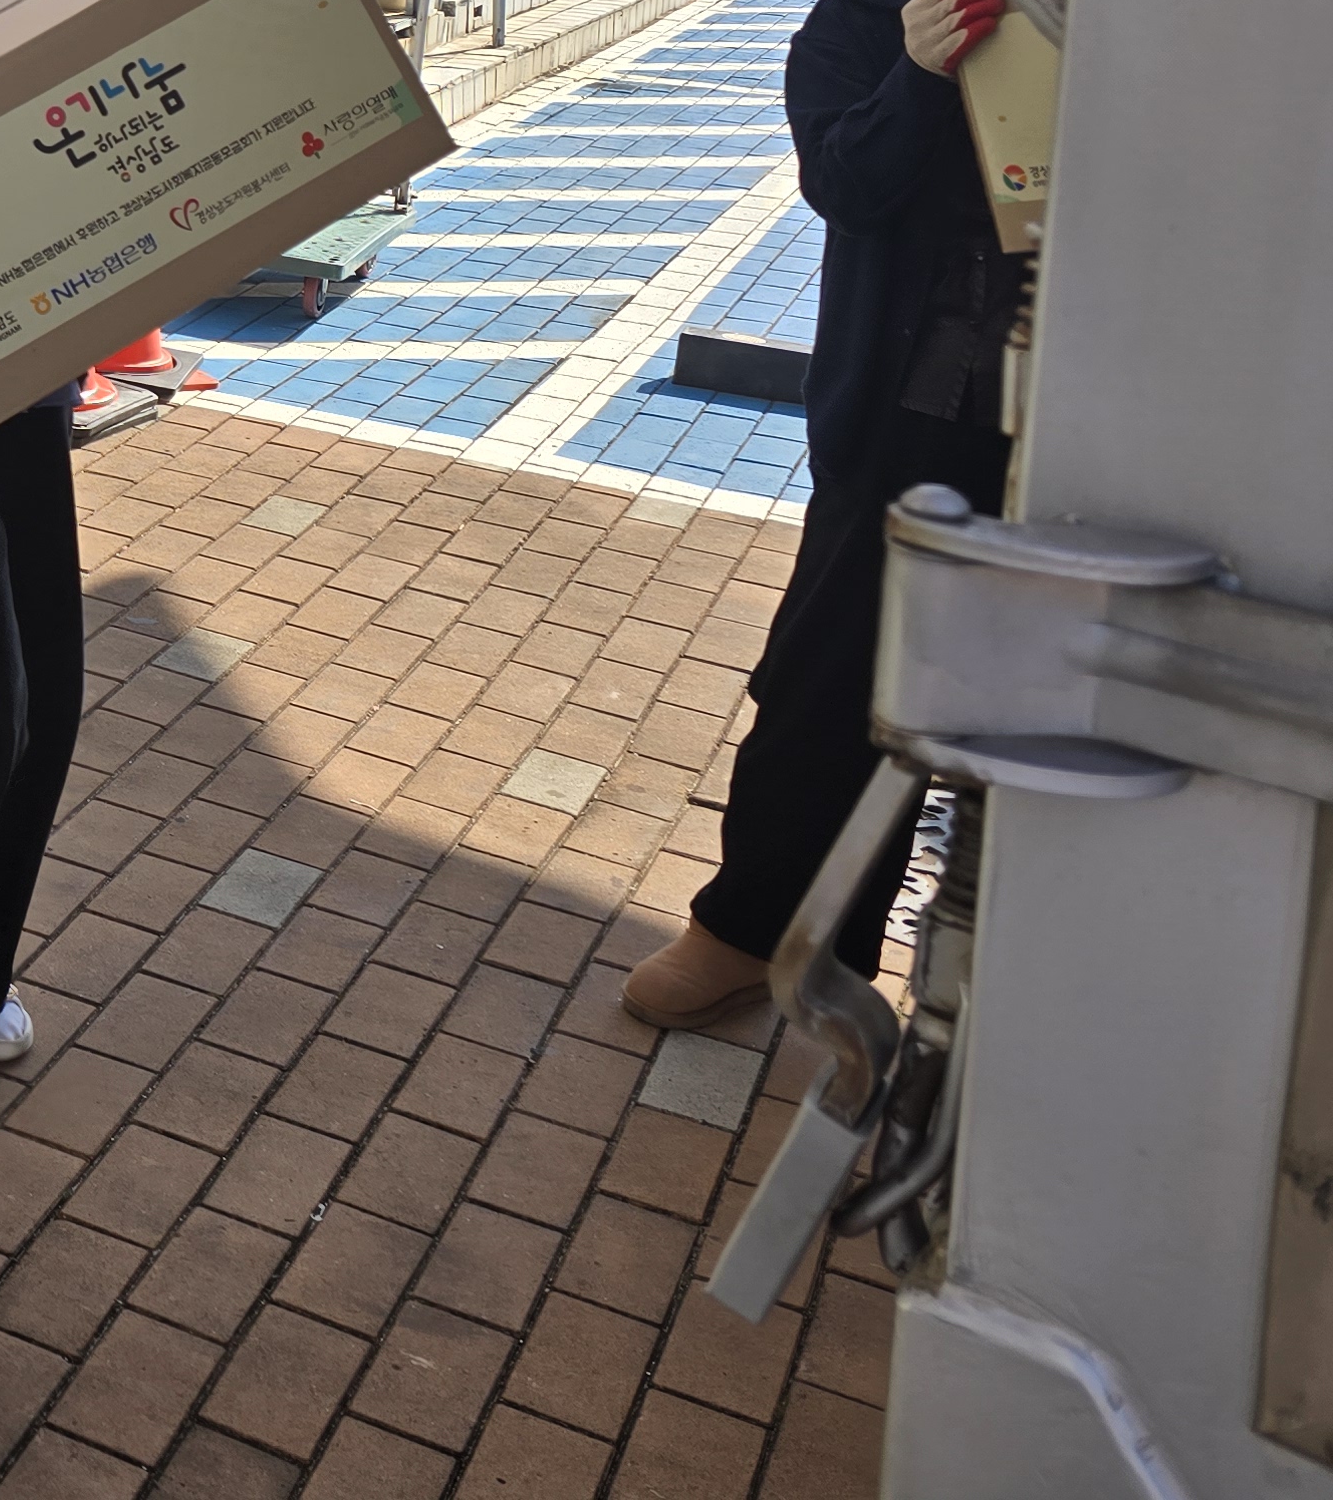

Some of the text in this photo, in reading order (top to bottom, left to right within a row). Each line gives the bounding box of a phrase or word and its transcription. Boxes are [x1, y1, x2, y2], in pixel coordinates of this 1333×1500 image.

[32, 57, 187, 169] 온기나눔
[93, 110, 165, 153] 하나되는
[323, 85, 398, 136] 사랑의열매
[75, 210, 121, 241] 후원하고
[261, 97, 317, 137] 지원합니다
[106, 135, 180, 183] 경상남도
[194, 162, 291, 225] 경상남도자원봉사센터
[50, 232, 158, 305] NH농협은행
